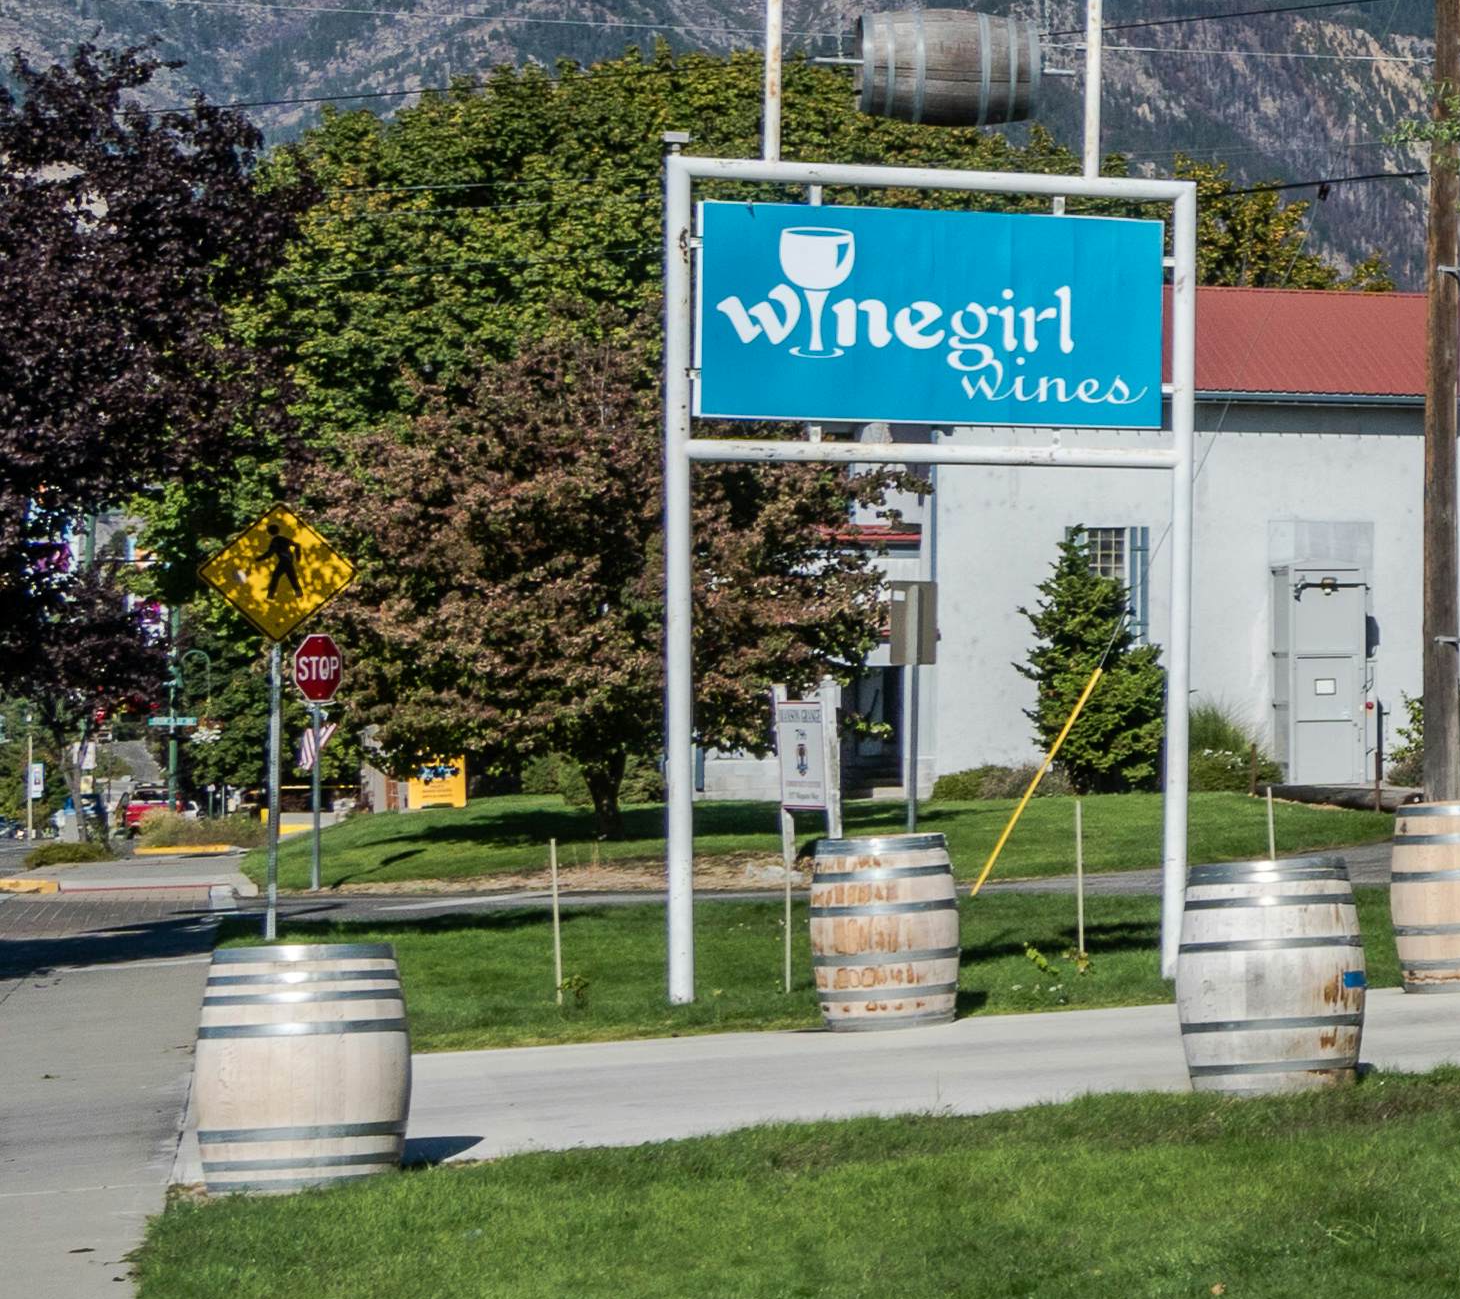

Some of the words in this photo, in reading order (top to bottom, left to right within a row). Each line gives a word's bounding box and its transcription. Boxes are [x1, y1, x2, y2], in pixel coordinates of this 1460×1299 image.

[716, 283, 1074, 371] winegirl
[961, 357, 1148, 405] wines
[298, 655, 339, 681] STOP
